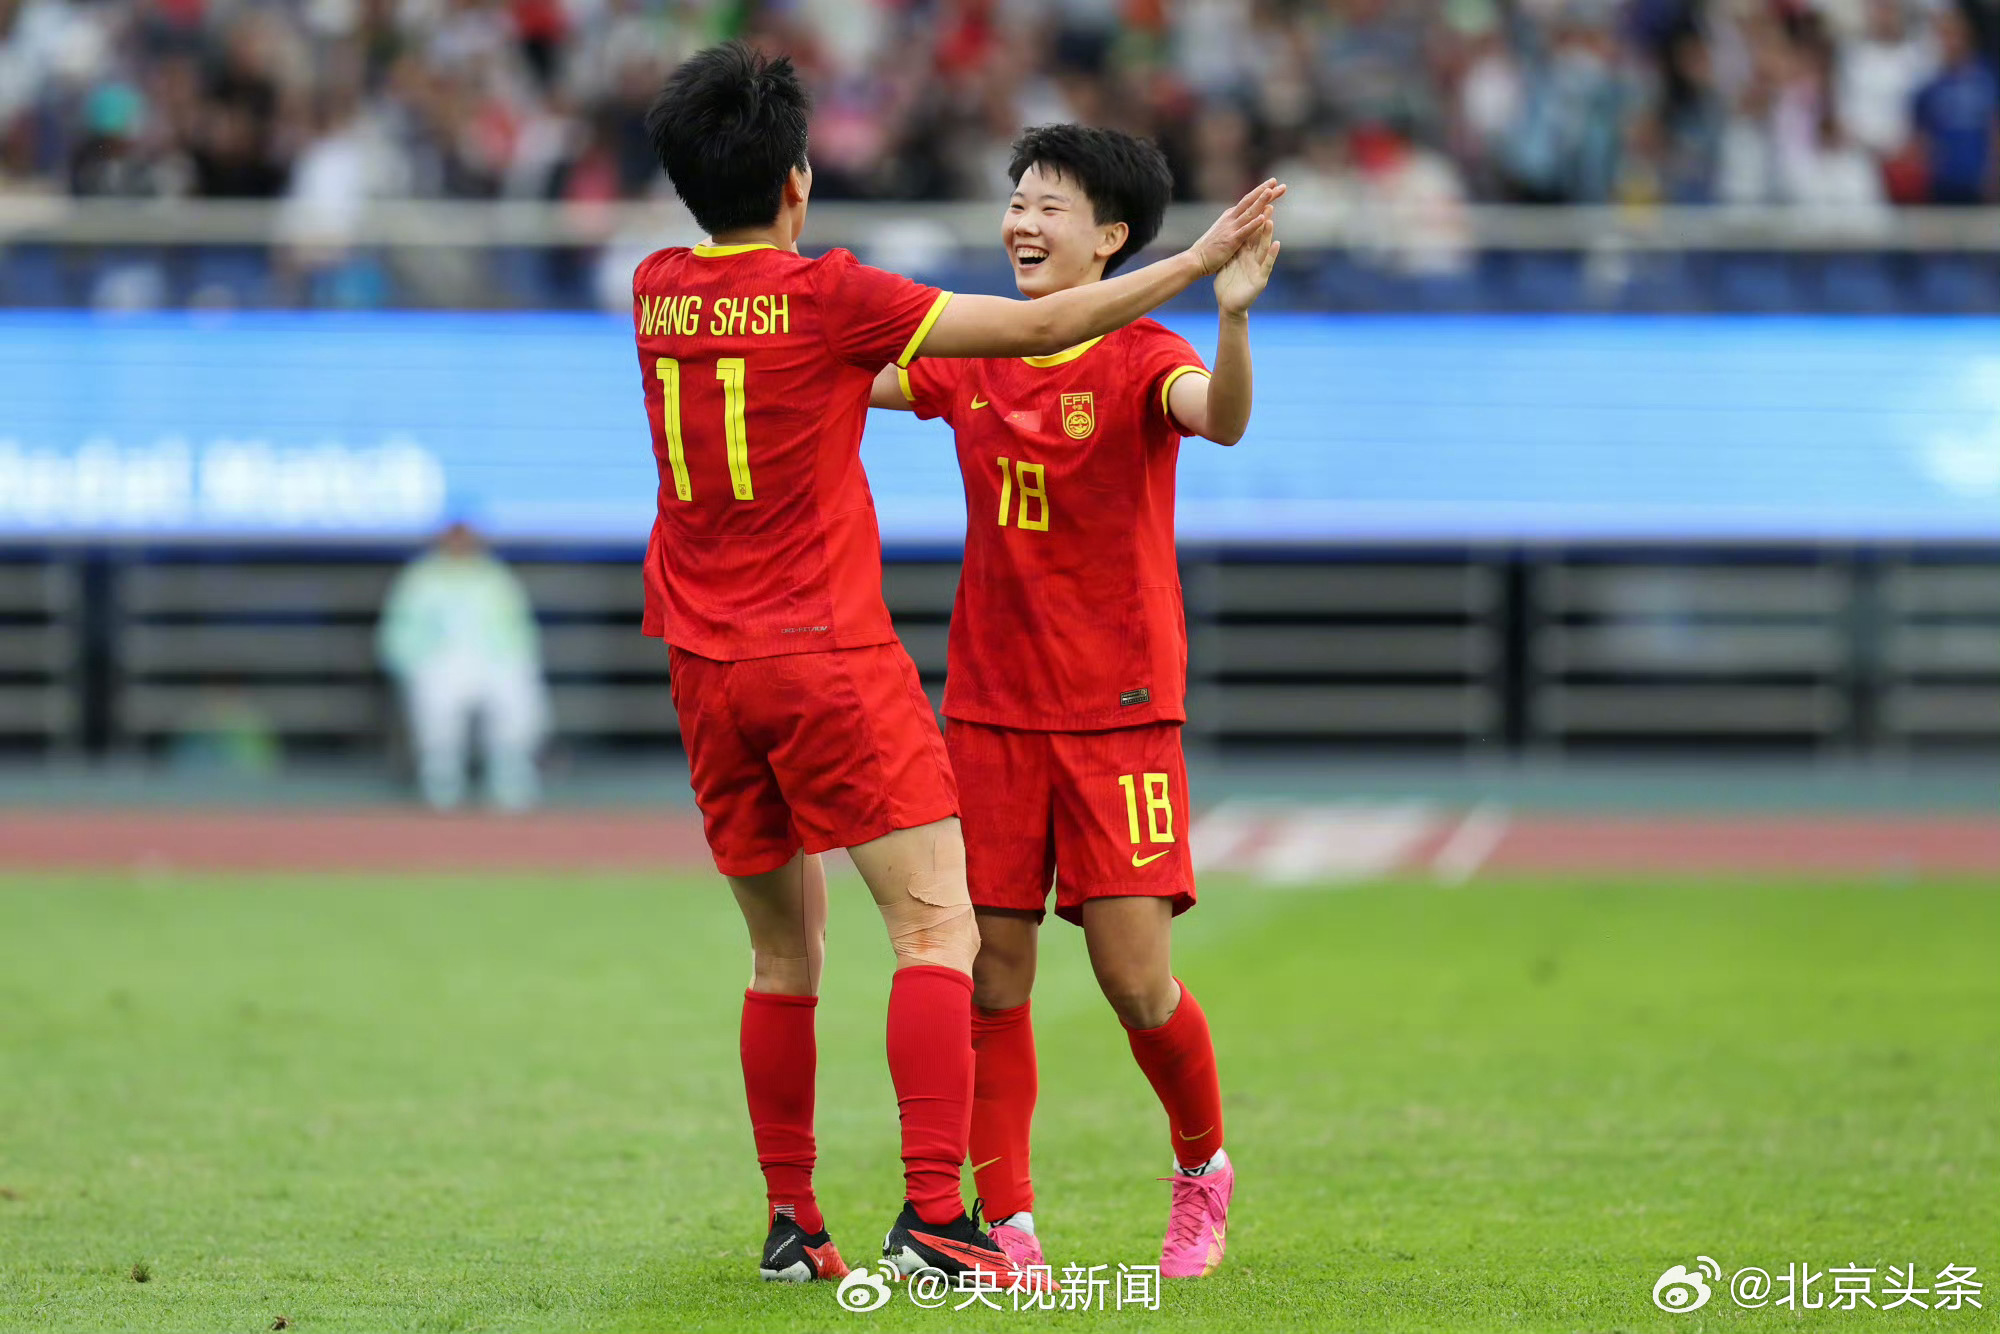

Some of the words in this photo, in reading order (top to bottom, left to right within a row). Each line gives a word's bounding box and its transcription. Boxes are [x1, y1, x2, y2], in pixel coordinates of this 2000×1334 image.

[710, 294, 789, 336] SHSH
[655, 357, 754, 502] 11
[1063, 395, 1091, 406] CFA
[997, 456, 1049, 532] 18
[1118, 773, 1176, 844] 18
